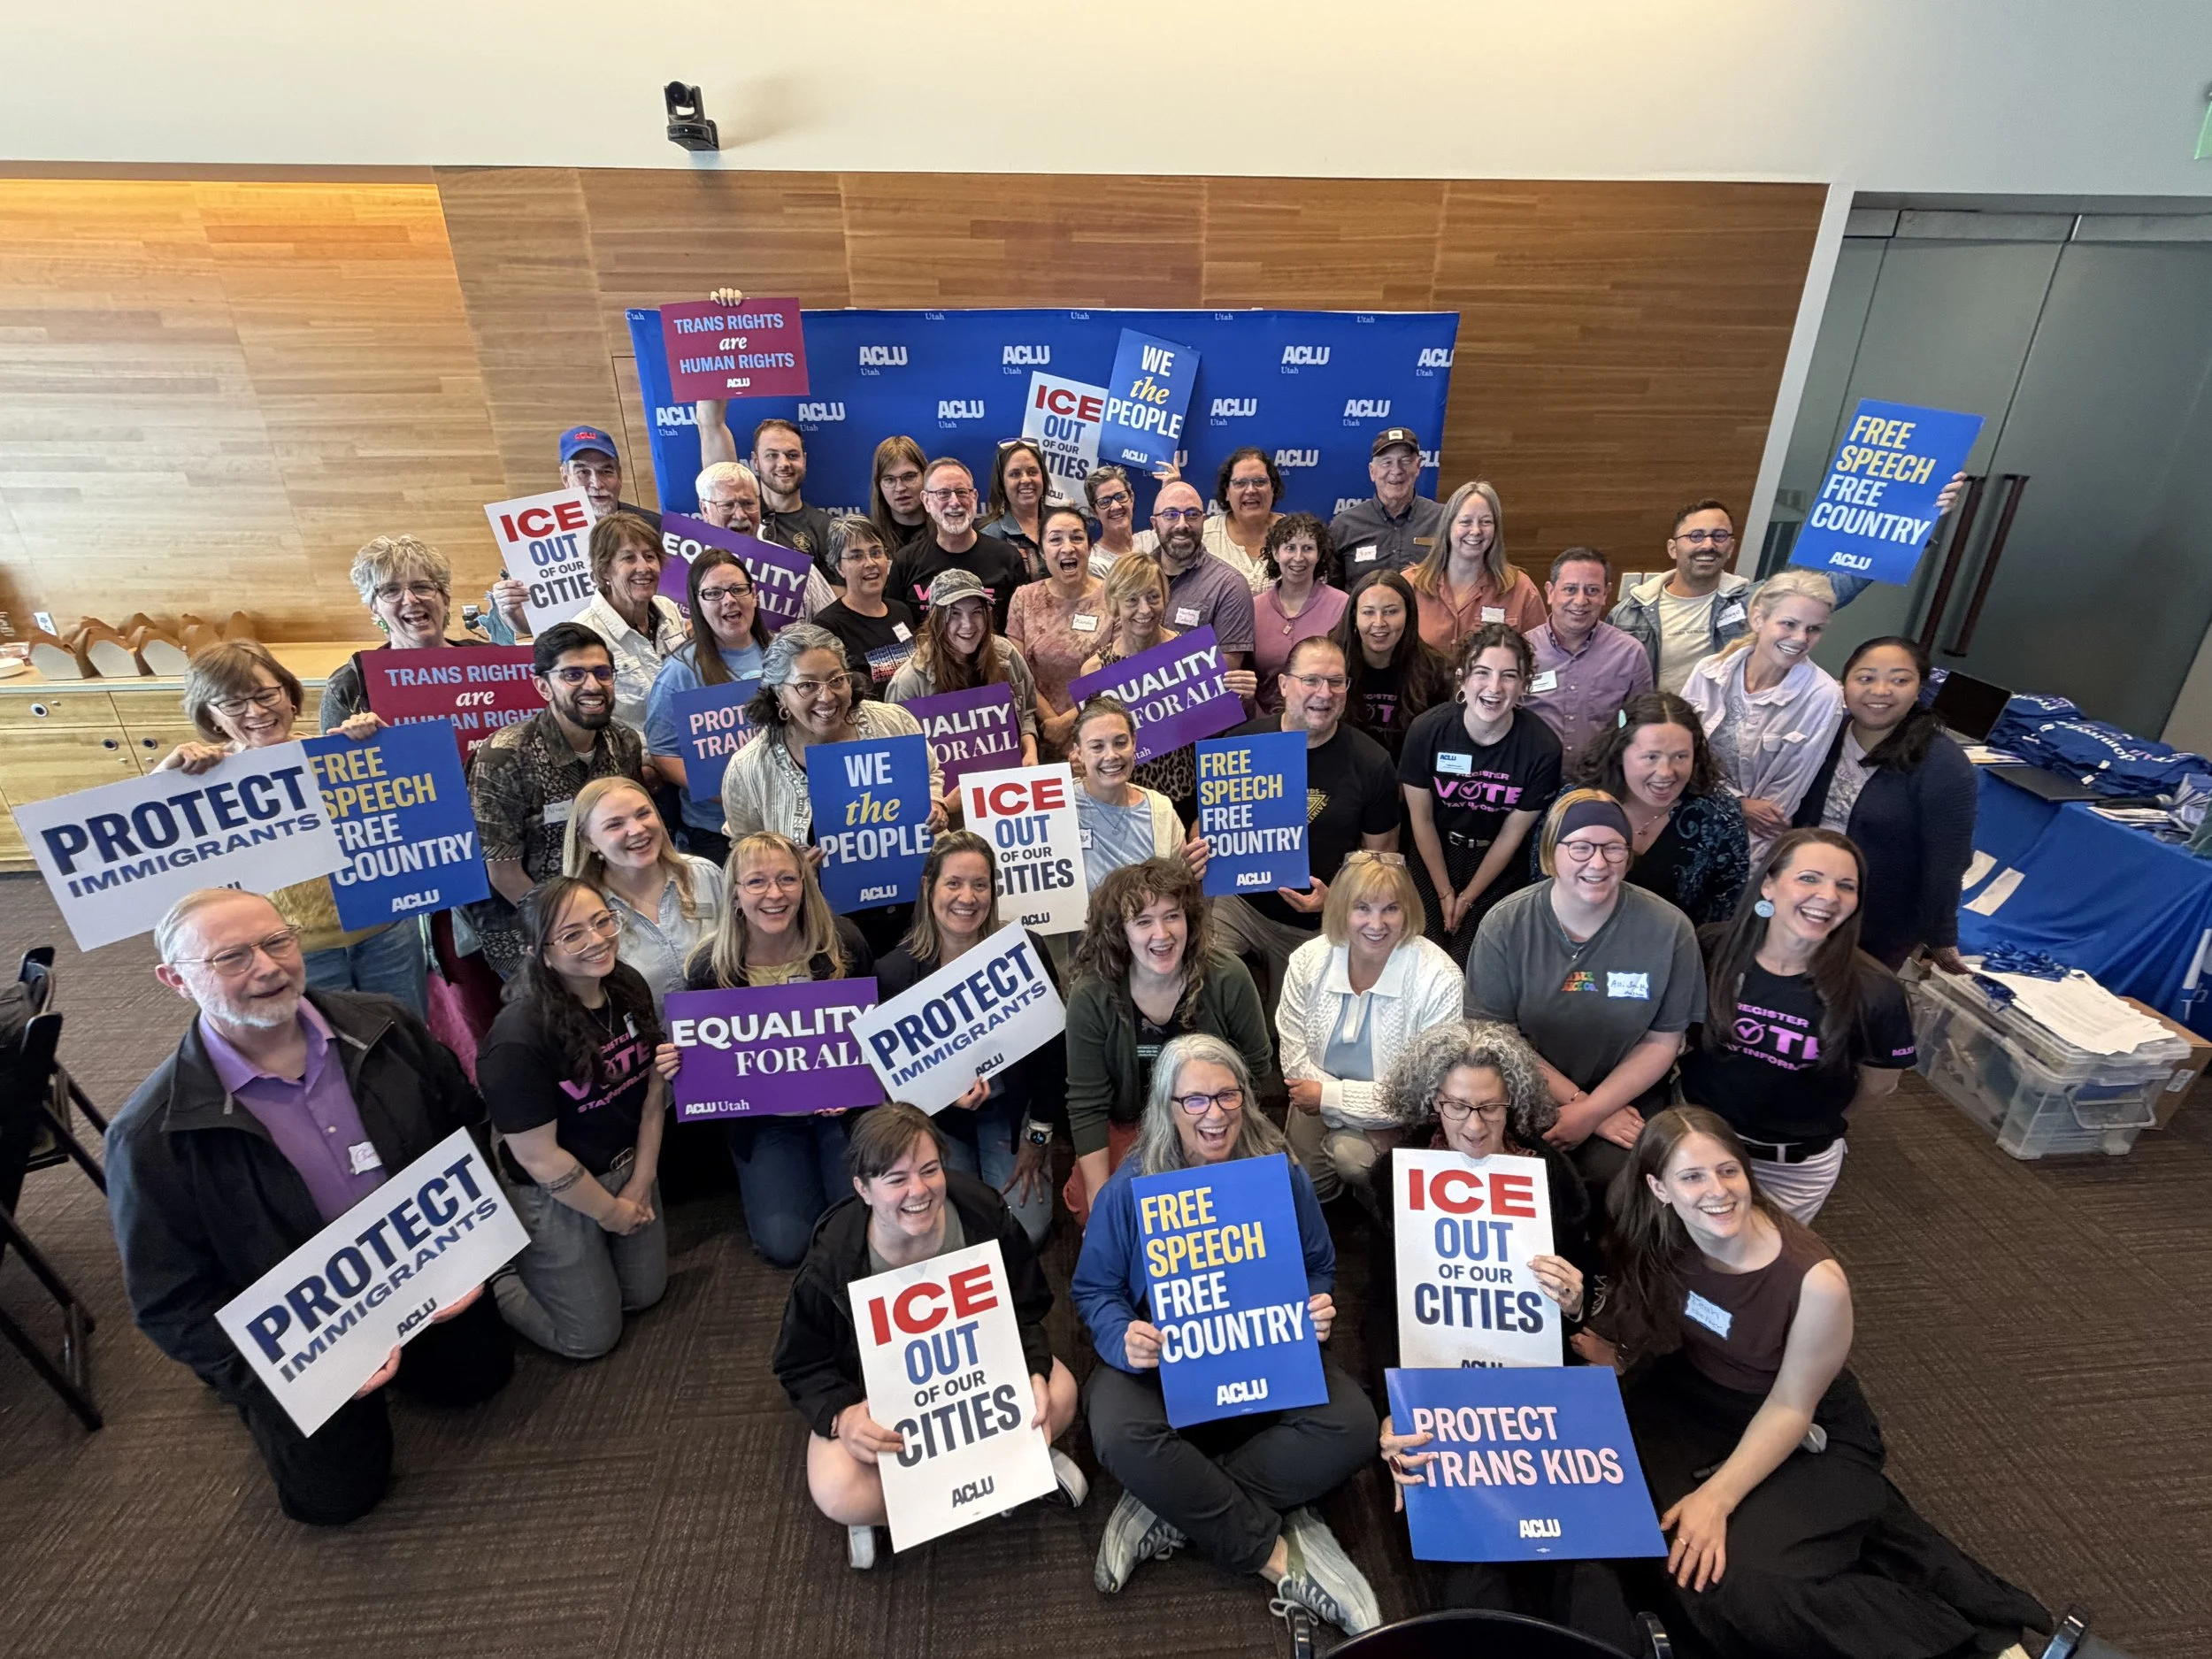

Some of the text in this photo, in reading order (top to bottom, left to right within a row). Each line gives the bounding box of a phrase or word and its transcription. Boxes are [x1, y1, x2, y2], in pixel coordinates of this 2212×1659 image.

[673, 313, 784, 334] TRANS RIGHTS
[1071, 311, 1090, 320] Utah
[719, 336, 748, 351] are
[859, 346, 908, 365] ACLU
[1002, 345, 1050, 365] ACLU
[1281, 346, 1330, 365] ACLU
[1417, 349, 1454, 367] ACL
[680, 352, 795, 374] HUMAN RIGHTS
[861, 367, 880, 376] Utah
[1002, 366, 1022, 375] Utah
[1141, 345, 1175, 377] WE
[1281, 366, 1299, 375] Utah
[726, 378, 750, 388] ACLU
[1130, 377, 1170, 405] the
[798, 402, 845, 422] ACLU
[938, 400, 985, 419] ACLU
[1035, 384, 1104, 423] ICE
[1106, 397, 1183, 440] PEOPLE
[1210, 398, 1257, 417] ACLU
[1344, 399, 1390, 418] ACLU
[658, 428, 679, 437] Utah
[1044, 415, 1086, 444] OUT
[1848, 415, 1916, 449] FREE
[1042, 439, 1079, 455] OF OUR
[1121, 449, 1148, 464] ACLU
[1274, 449, 1318, 467] ACLU
[1041, 449, 1089, 481] ITIES
[1836, 445, 1936, 485] SPEECH
[1823, 473, 1887, 508] FREE
[500, 500, 588, 543] ICE
[1810, 503, 1932, 546] COUNTRY
[529, 534, 580, 566] OUT
[1829, 551, 1872, 571] ACLU
[540, 560, 585, 579] OF OUR
[385, 666, 463, 687] TRANS
[456, 690, 495, 707] are
[1133, 672, 1233, 731] FOR ALL
[934, 728, 1019, 765] OR ALL
[844, 751, 893, 787] WE
[1200, 749, 1252, 779] FREE
[320, 772, 437, 820] SPEECH
[972, 777, 1066, 818] ICE
[1200, 774, 1282, 805] SPEECH
[41, 765, 308, 876] PROTECT
[845, 791, 901, 826] the
[1202, 804, 1253, 832] FREE
[819, 822, 933, 868] PEOPLE
[995, 814, 1050, 849] OUT
[1204, 826, 1303, 858] COUNTRY
[67, 812, 321, 898] IMMIGRANTS
[334, 831, 474, 887] COUNTRY
[1000, 846, 1052, 863] OF OUR
[860, 884, 897, 902] ACLU
[1236, 872, 1271, 887] ACLU
[391, 888, 440, 913] ACLU
[1020, 912, 1050, 927] ACLU
[868, 941, 1035, 1071] PROTECT
[891, 981, 1048, 1087] IMMIGRANTS
[735, 1046, 810, 1077] FOR
[975, 1053, 1004, 1078] ACLU
[685, 1099, 750, 1115] ACLU Utah
[1409, 1168, 1536, 1218] ICE
[1140, 1186, 1217, 1235] FREE
[1146, 1221, 1266, 1278] SPEECH
[1434, 1217, 1513, 1262] OUT
[246, 1153, 482, 1365] PROTECT
[1438, 1263, 1513, 1284] OF OUR
[280, 1197, 498, 1383] IMMIGRANTS
[868, 1263, 999, 1346] ICE
[1153, 1271, 1231, 1321] FREE
[396, 1297, 438, 1338] ACLU
[1415, 1283, 1544, 1333] CITIES
[1161, 1301, 1304, 1364] COUNTRY
[904, 1320, 979, 1386] OUT
[914, 1370, 987, 1408] OF OUR
[1217, 1378, 1268, 1406] ACLU
[893, 1383, 1022, 1468] CITIES
[1412, 1406, 1557, 1443] PROTECT
[1417, 1448, 1624, 1486] TRANS KIDS
[951, 1476, 995, 1509] ACLU
[1519, 1518, 1562, 1538] ACLU
